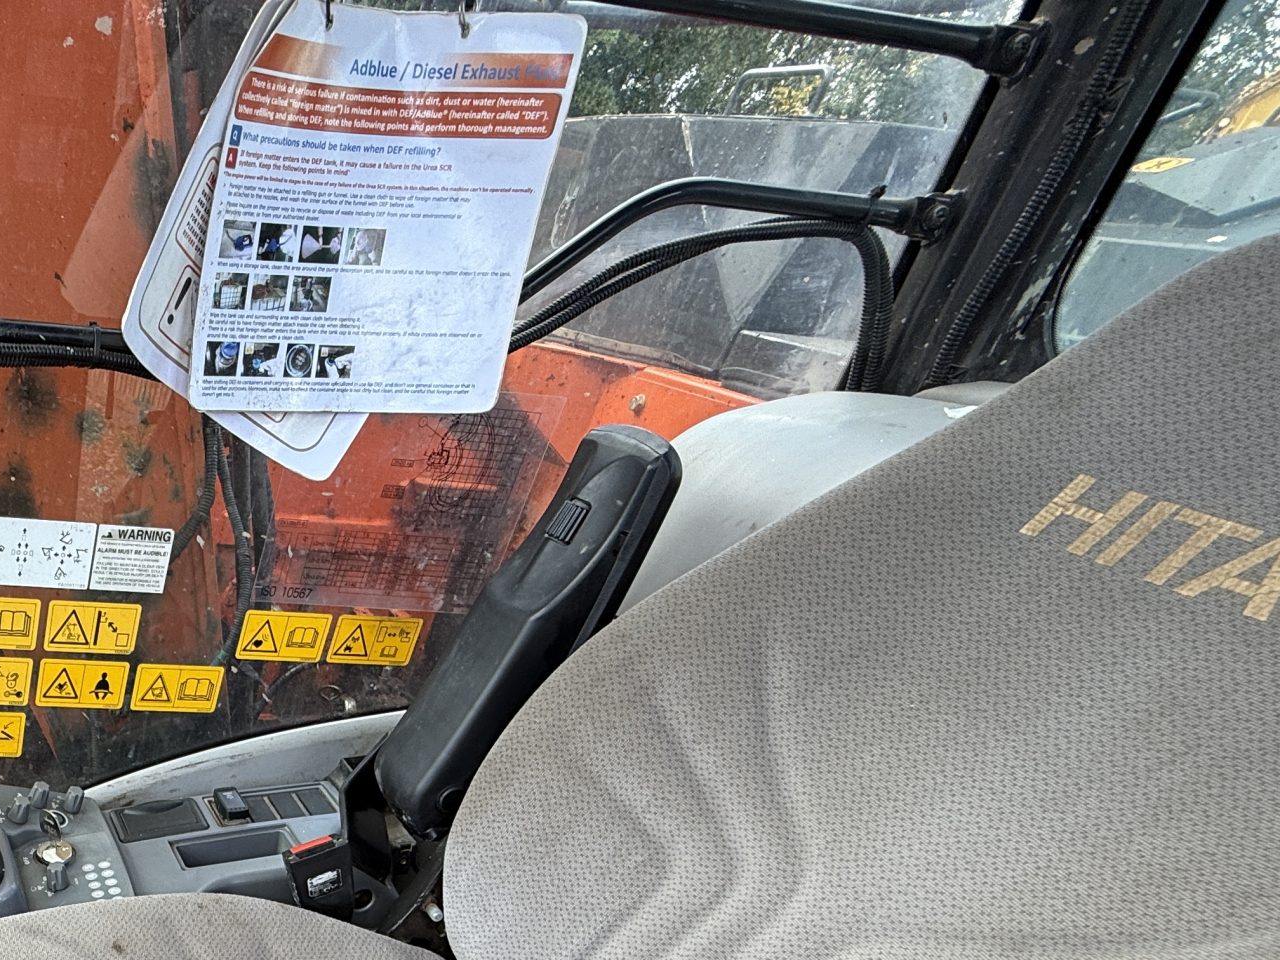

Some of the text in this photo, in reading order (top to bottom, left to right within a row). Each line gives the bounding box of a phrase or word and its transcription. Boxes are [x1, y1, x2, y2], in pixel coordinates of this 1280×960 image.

[350, 60, 398, 79] Adblue
[400, 62, 410, 82] /
[412, 62, 458, 80] Diesel
[461, 64, 520, 80] Exhaust
[252, 77, 266, 89] There
[267, 80, 270, 90] is
[272, 83, 276, 91] a
[277, 82, 287, 93] risk
[288, 85, 294, 95] of
[295, 86, 317, 97] serious
[318, 88, 339, 99] failure
[340, 90, 345, 100] if
[346, 91, 396, 103] contamination
[398, 94, 414, 104] such
[426, 96, 441, 108] dirt,
[443, 97, 460, 106] dust
[473, 97, 496, 106] water
[497, 97, 544, 108] (hereinafter
[242, 90, 270, 106] collectively
[272, 96, 288, 107] called
[344, 105, 349, 114] is
[351, 106, 372, 116] mixed
[374, 107, 380, 116] in
[382, 107, 398, 117] with
[449, 110, 494, 121] (hereinafter
[496, 111, 520, 120] called
[239, 104, 547, 135] When refilling and storing DEF, note the following points and perform thorough management.
[243, 132, 441, 157] What precautions should be taken when DEF refilling?
[246, 150, 263, 161] foreign
[264, 153, 280, 161] matter
[283, 155, 299, 163] enters
[301, 156, 310, 164] the
[312, 157, 322, 165] DEF
[324, 158, 337, 168] tank,
[346, 161, 358, 169] may
[383, 162, 402, 170] failure
[411, 163, 421, 171] the
[259, 162, 272, 171] Keep
[273, 163, 281, 171] the
[283, 164, 306, 175] following
[308, 167, 325, 177] points
[118, 529, 171, 542] WARNING
[261, 585, 313, 598] ISO 10567
